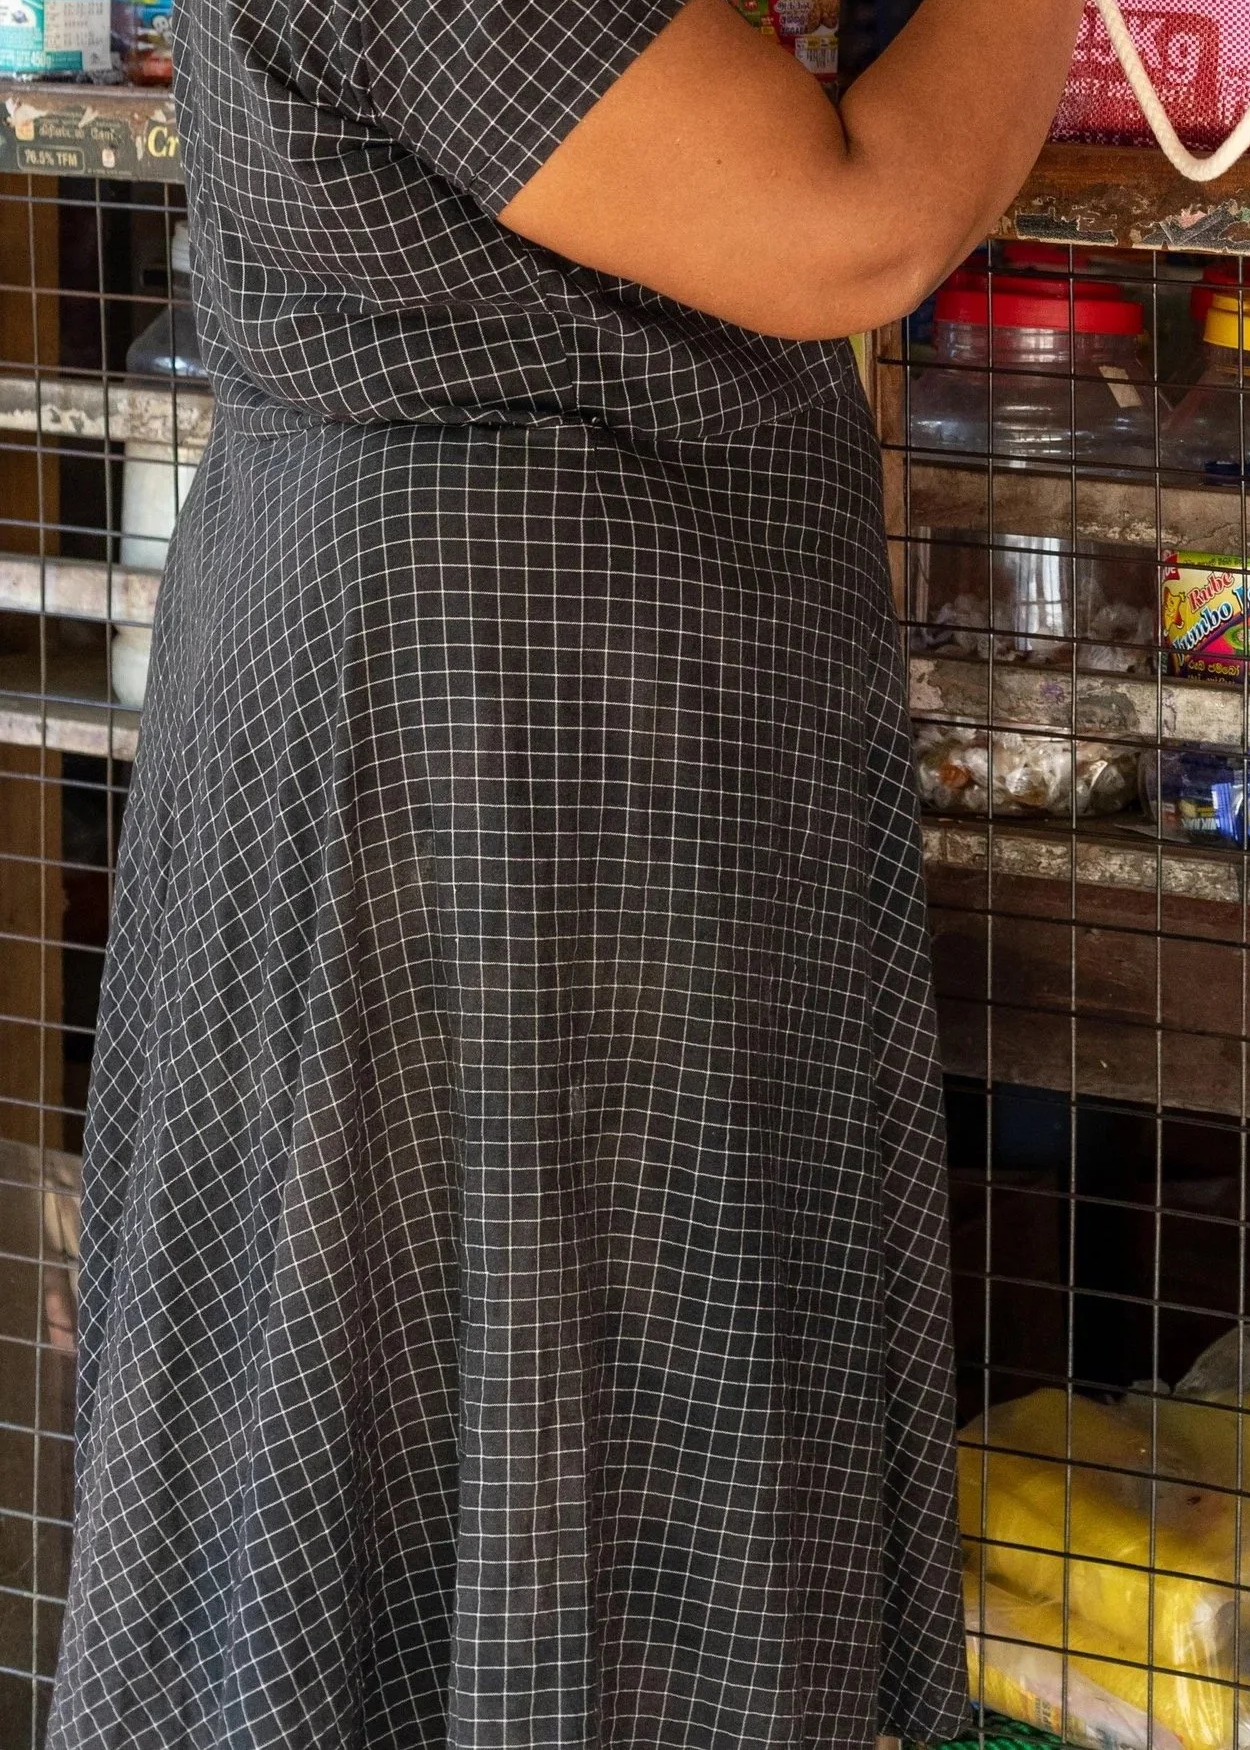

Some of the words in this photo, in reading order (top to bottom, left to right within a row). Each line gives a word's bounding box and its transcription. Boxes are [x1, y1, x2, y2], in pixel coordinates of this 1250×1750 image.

[147, 125, 179, 158] Cr
[56, 151, 78, 167] TFM
[1187, 572, 1235, 614] Rube
